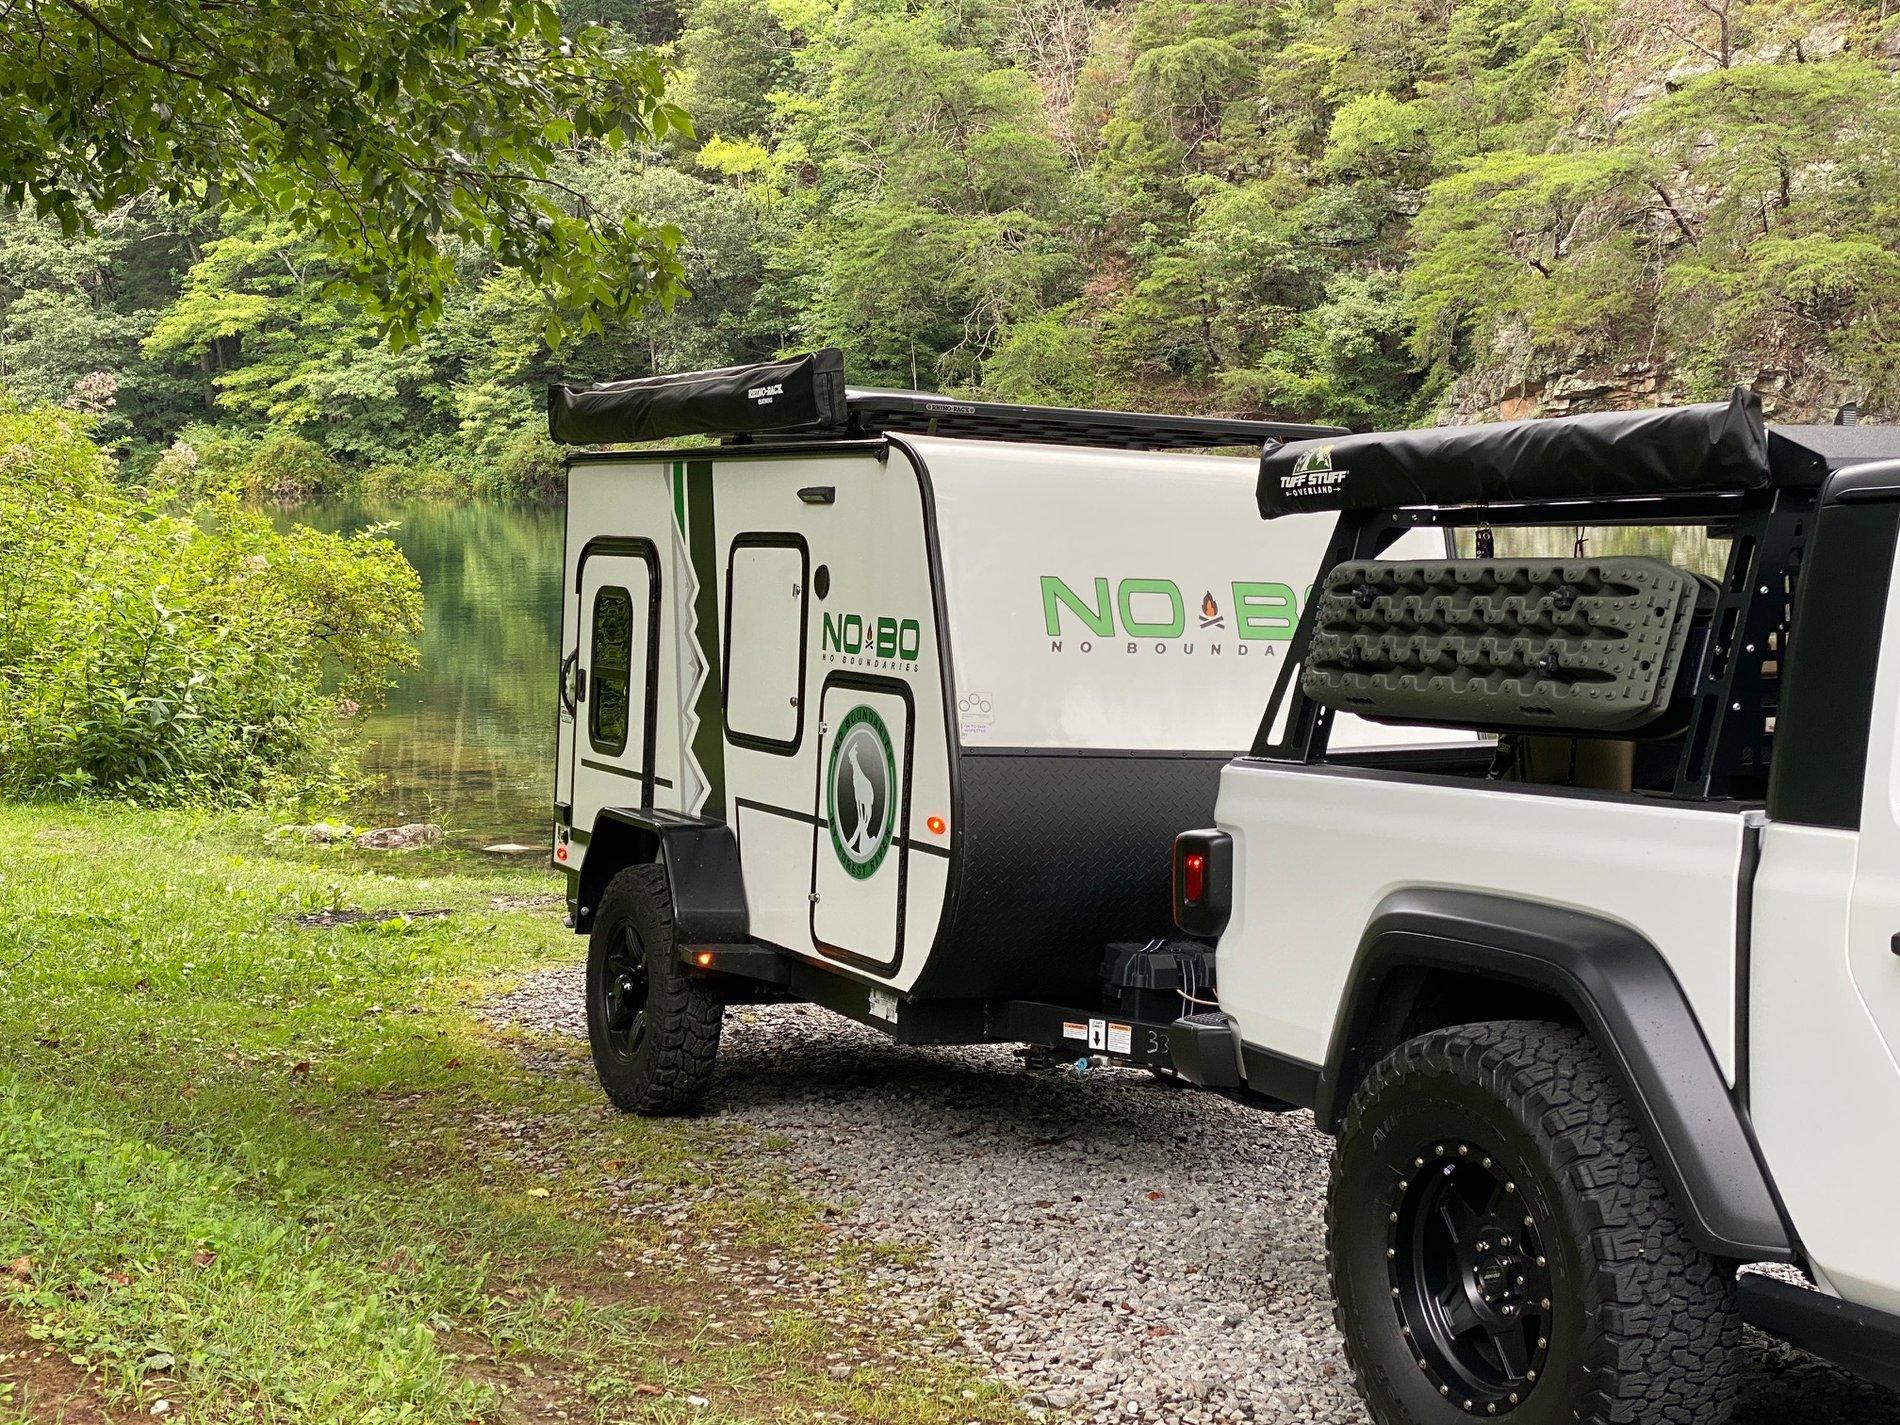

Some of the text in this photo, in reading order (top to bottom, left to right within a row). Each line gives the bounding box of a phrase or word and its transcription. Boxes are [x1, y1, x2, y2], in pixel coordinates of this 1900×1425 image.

[1280, 471, 1347, 488] TUFF STUFF
[1292, 485, 1334, 497] OVERLAND
[1040, 576, 1313, 640] NO B
[822, 612, 920, 661] NO BO
[1050, 641, 1275, 656] NO BOUNDA
[822, 653, 919, 673] NO BOUNDARIES
[844, 708, 894, 763] BOUNDARIES
[837, 845, 867, 876] FOREST
[869, 828, 892, 872] RIVER
